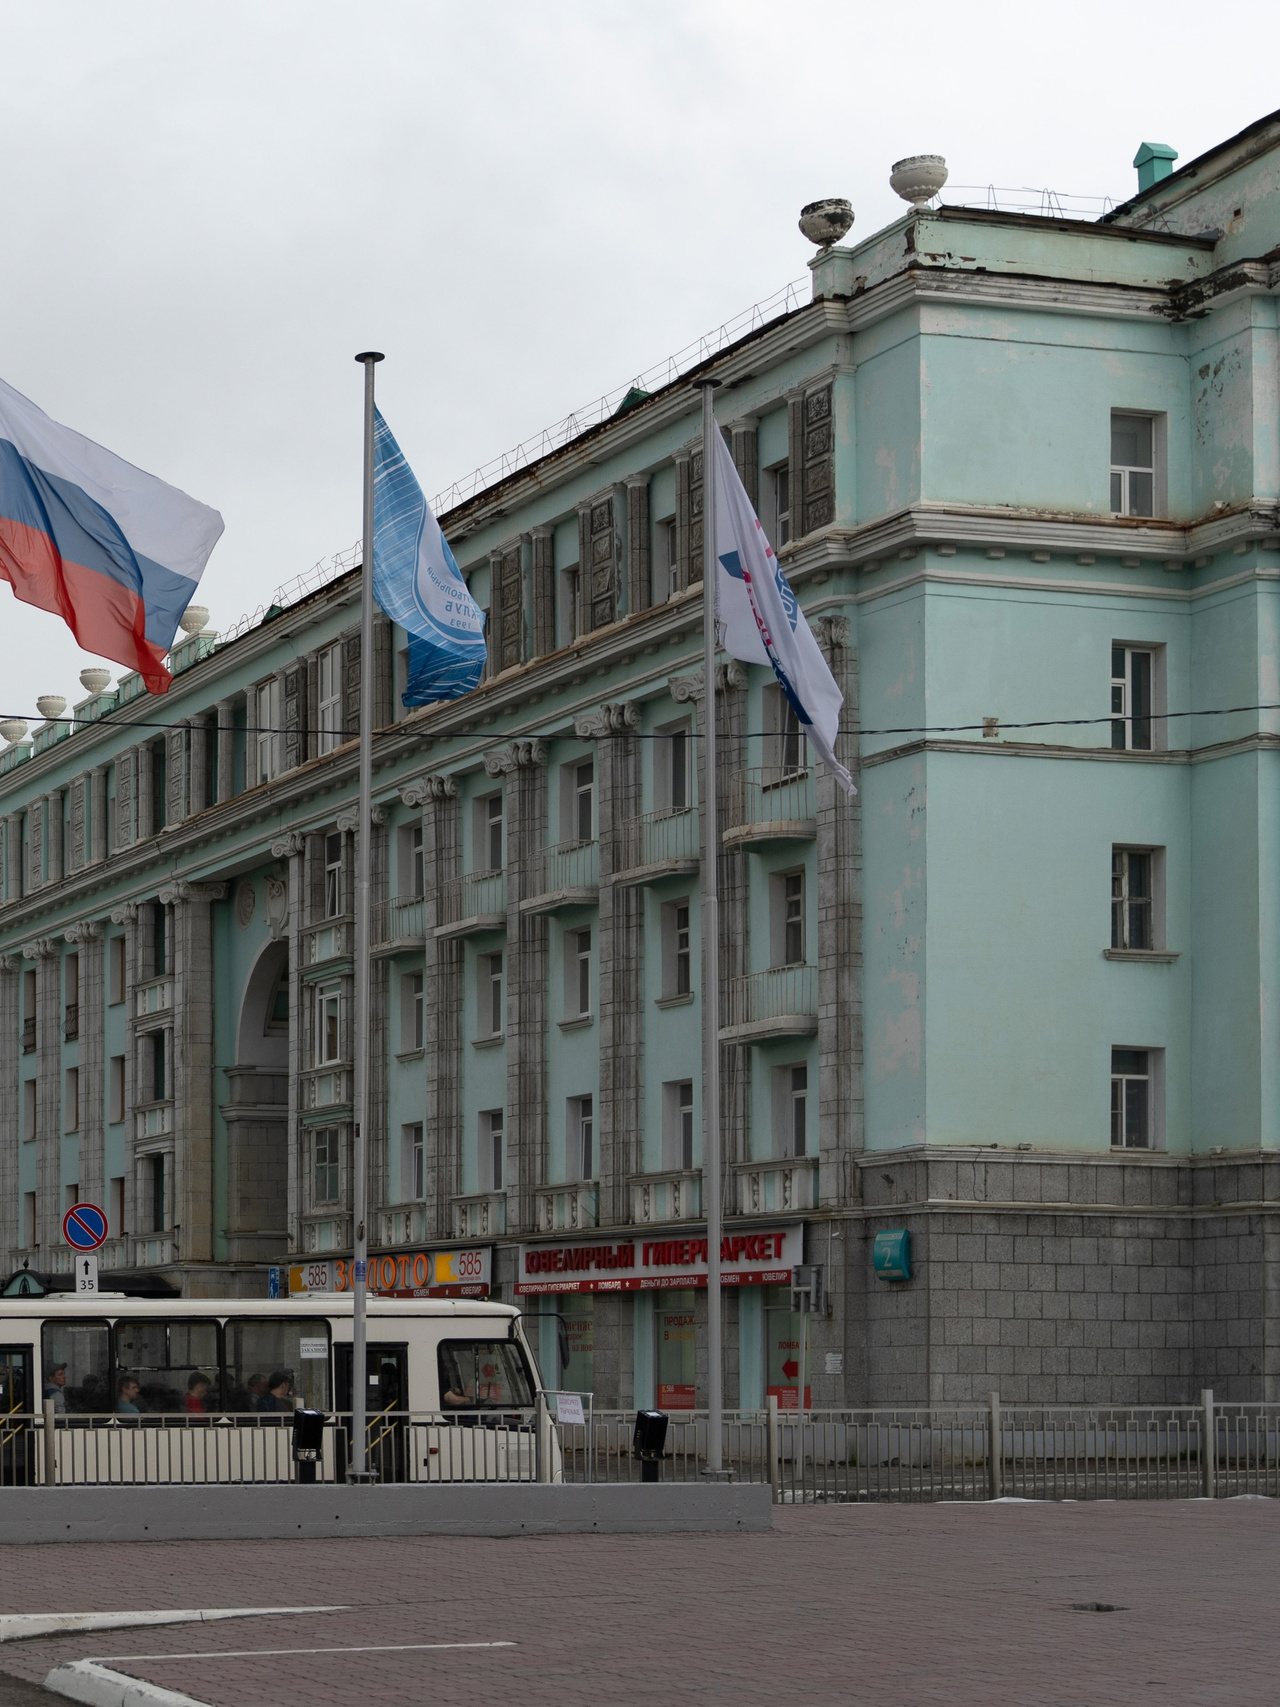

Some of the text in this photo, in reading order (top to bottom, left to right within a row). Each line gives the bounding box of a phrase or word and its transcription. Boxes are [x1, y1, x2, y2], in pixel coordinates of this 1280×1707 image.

[459, 1252, 482, 1276] 585
[525, 1239, 635, 1274] ЮВЕЛИРНЫЙ
[883, 1247, 892, 1267] 2
[80, 1279, 94, 1290] 35
[308, 1265, 327, 1286] 585
[519, 1271, 787, 1293] ЮВЕЛИРНЫЙ ГИПЕРМАРКЕТ ЛОМБАРД ДЕНЬГИ ДО ЗАРПЛАТЫ ОБМЕН ЮВЕЛИР
[413, 1285, 482, 1297] ОБМЕН ЮВЕЛИР
